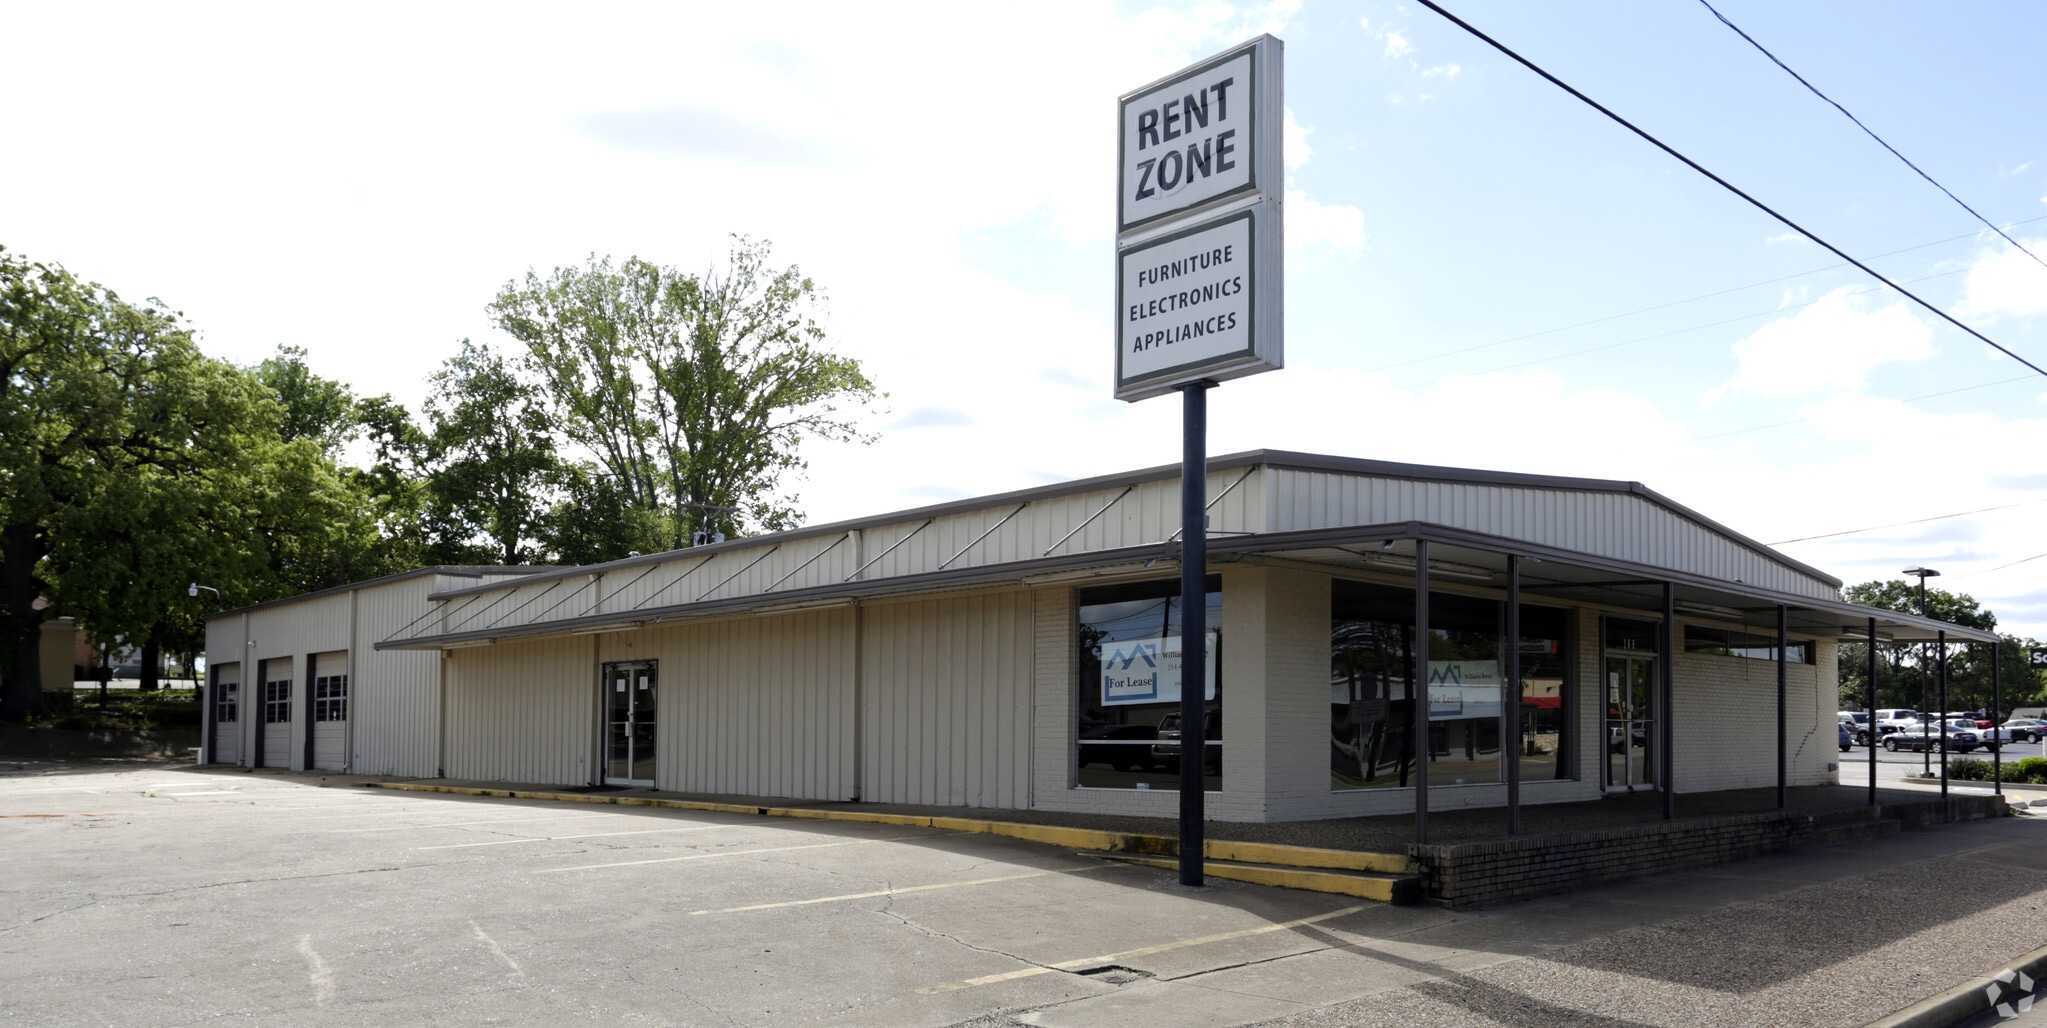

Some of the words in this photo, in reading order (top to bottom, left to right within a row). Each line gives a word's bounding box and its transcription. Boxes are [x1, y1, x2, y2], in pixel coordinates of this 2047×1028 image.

[1138, 76, 1234, 151] RENT
[1135, 128, 1236, 202] ZONE
[1138, 244, 1233, 288] FURNITURE
[1129, 275, 1242, 322] ELECTRONICS
[1132, 311, 1237, 353] APPLIANCES
[1162, 651, 1183, 660] Willia
[1109, 678, 1124, 688] For
[1127, 676, 1152, 687] Lease
